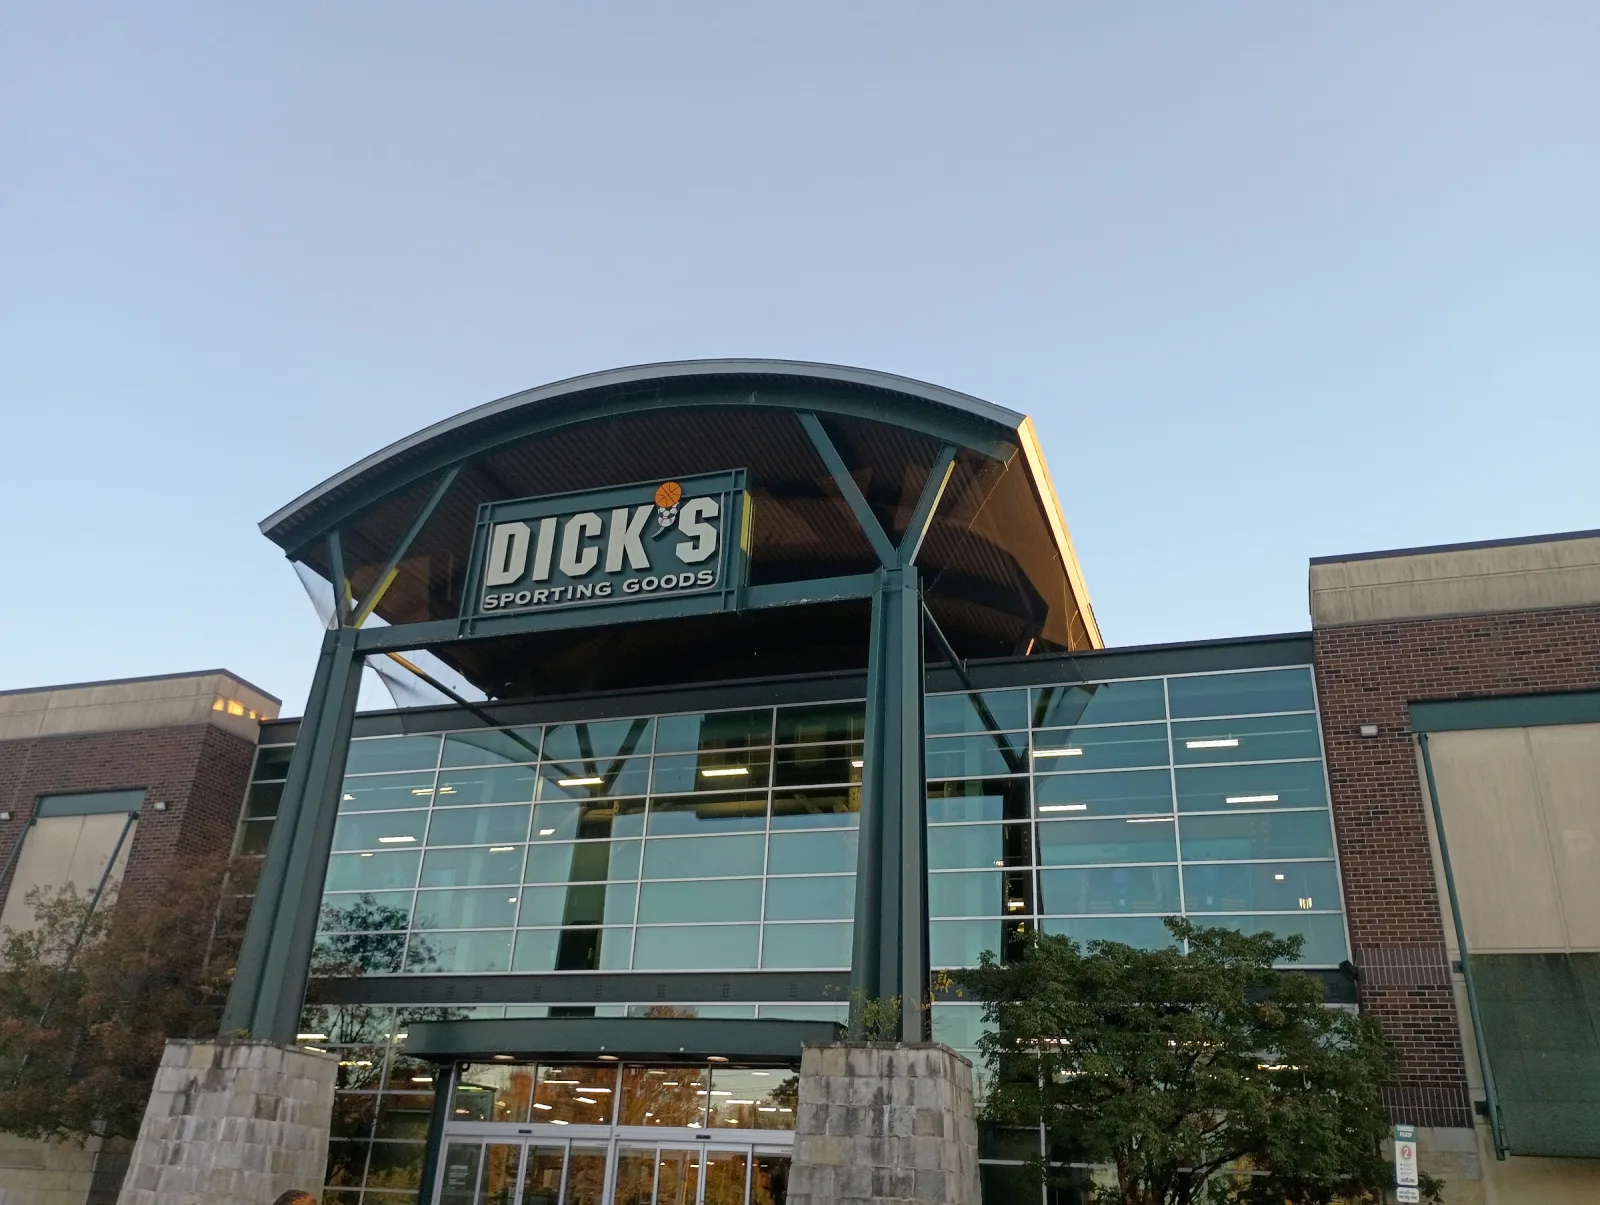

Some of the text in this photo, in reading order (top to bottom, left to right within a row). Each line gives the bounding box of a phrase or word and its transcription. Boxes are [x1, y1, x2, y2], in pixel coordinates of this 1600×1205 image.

[486, 481, 719, 587] DICK'S
[483, 570, 714, 609] SPORTING GOODS
